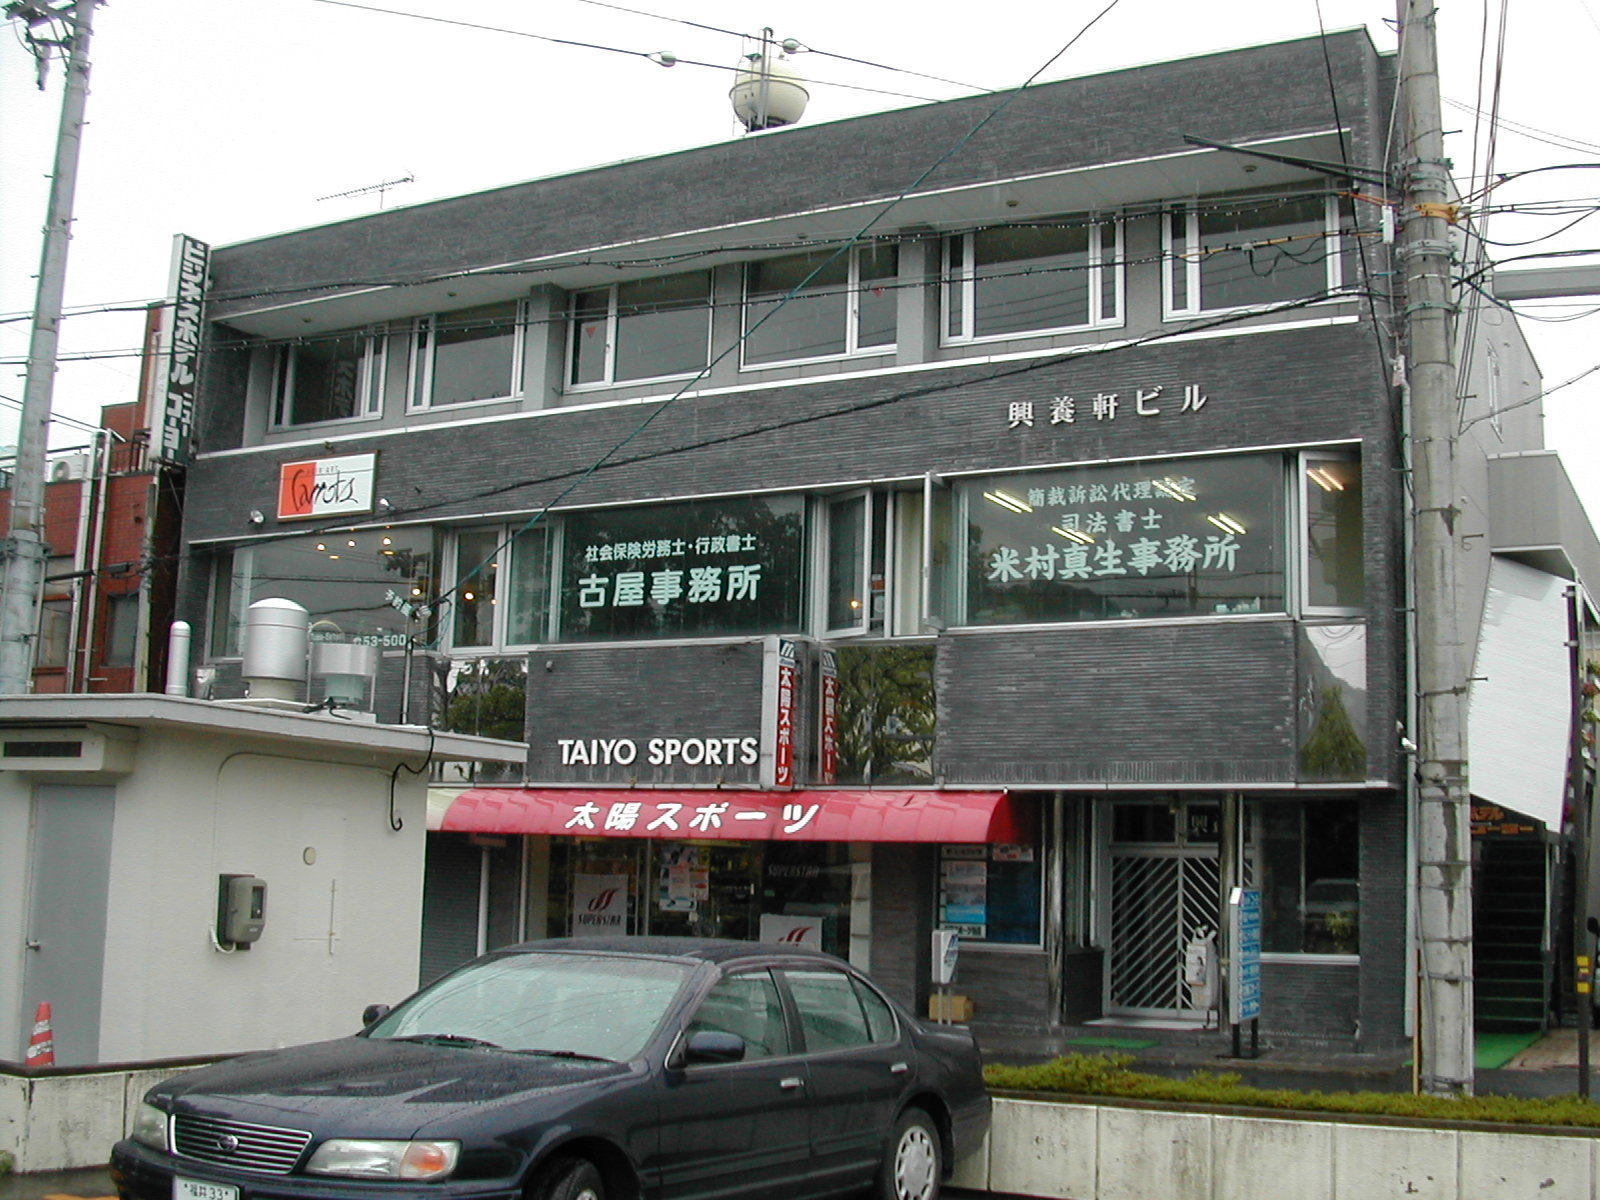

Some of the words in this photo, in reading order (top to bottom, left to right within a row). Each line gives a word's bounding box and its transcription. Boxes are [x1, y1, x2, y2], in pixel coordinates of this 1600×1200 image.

[171, 239, 206, 386] ビジネスホテル
[1007, 384, 1209, 429] 興養軒ビル
[1061, 508, 1163, 534] 司法書士
[988, 533, 1241, 583] 米村真生事務所
[578, 564, 762, 608] 古屋事務所
[778, 667, 792, 783] 太陽スポーツ
[558, 739, 637, 766] TAIYO
[648, 738, 760, 765] SPORTS
[565, 802, 820, 834] 太陽スポーツ
